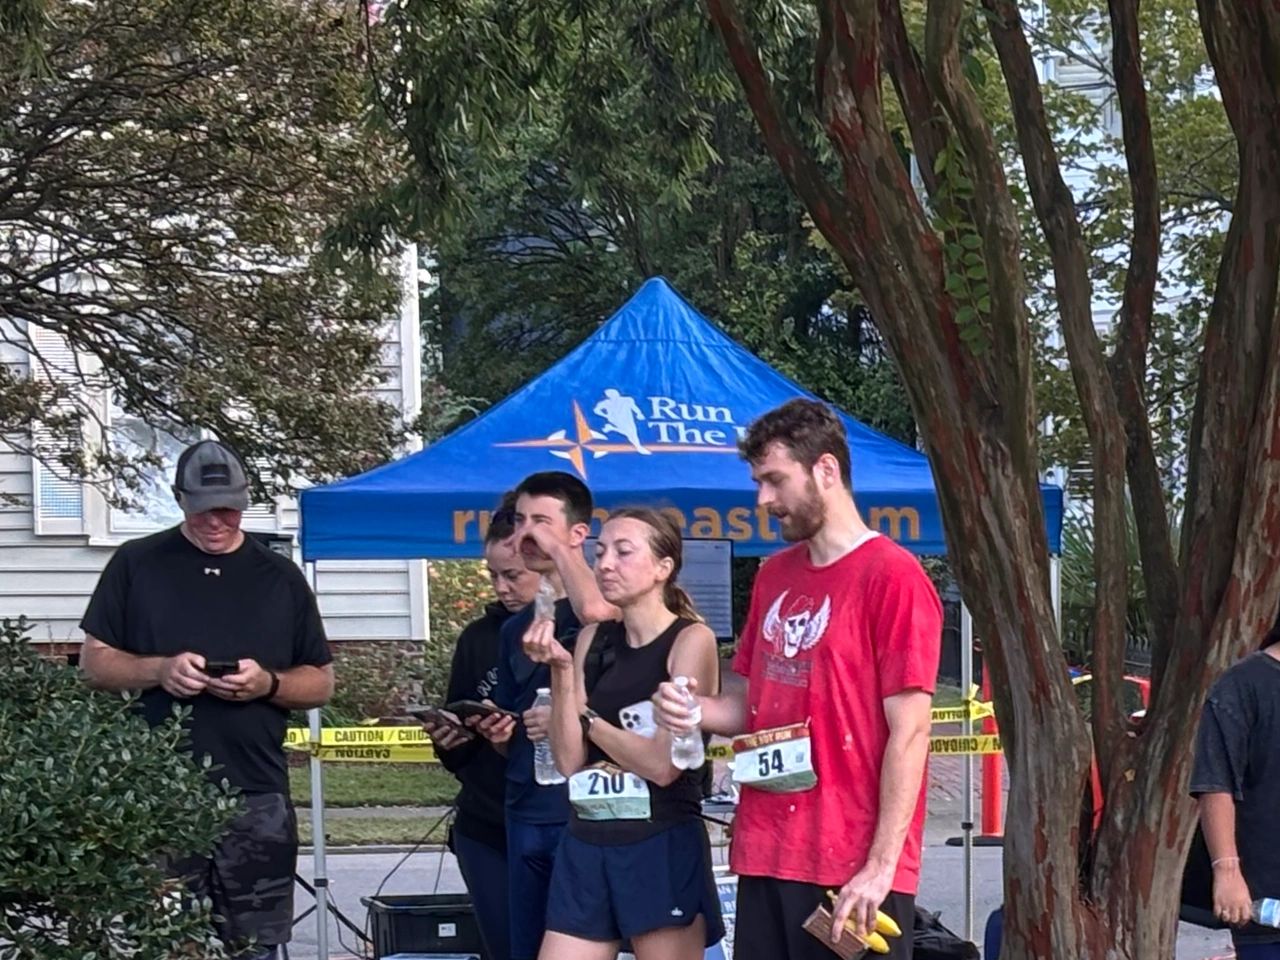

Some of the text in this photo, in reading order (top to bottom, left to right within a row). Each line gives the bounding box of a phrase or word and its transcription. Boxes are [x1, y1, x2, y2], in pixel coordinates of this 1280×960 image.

[647, 396, 735, 424] Run
[648, 421, 727, 445] The
[931, 709, 971, 720] AUTION
[334, 729, 384, 742] CAUTION
[335, 748, 391, 759] CAUTION
[758, 749, 784, 777] 54
[588, 772, 625, 795] 210
